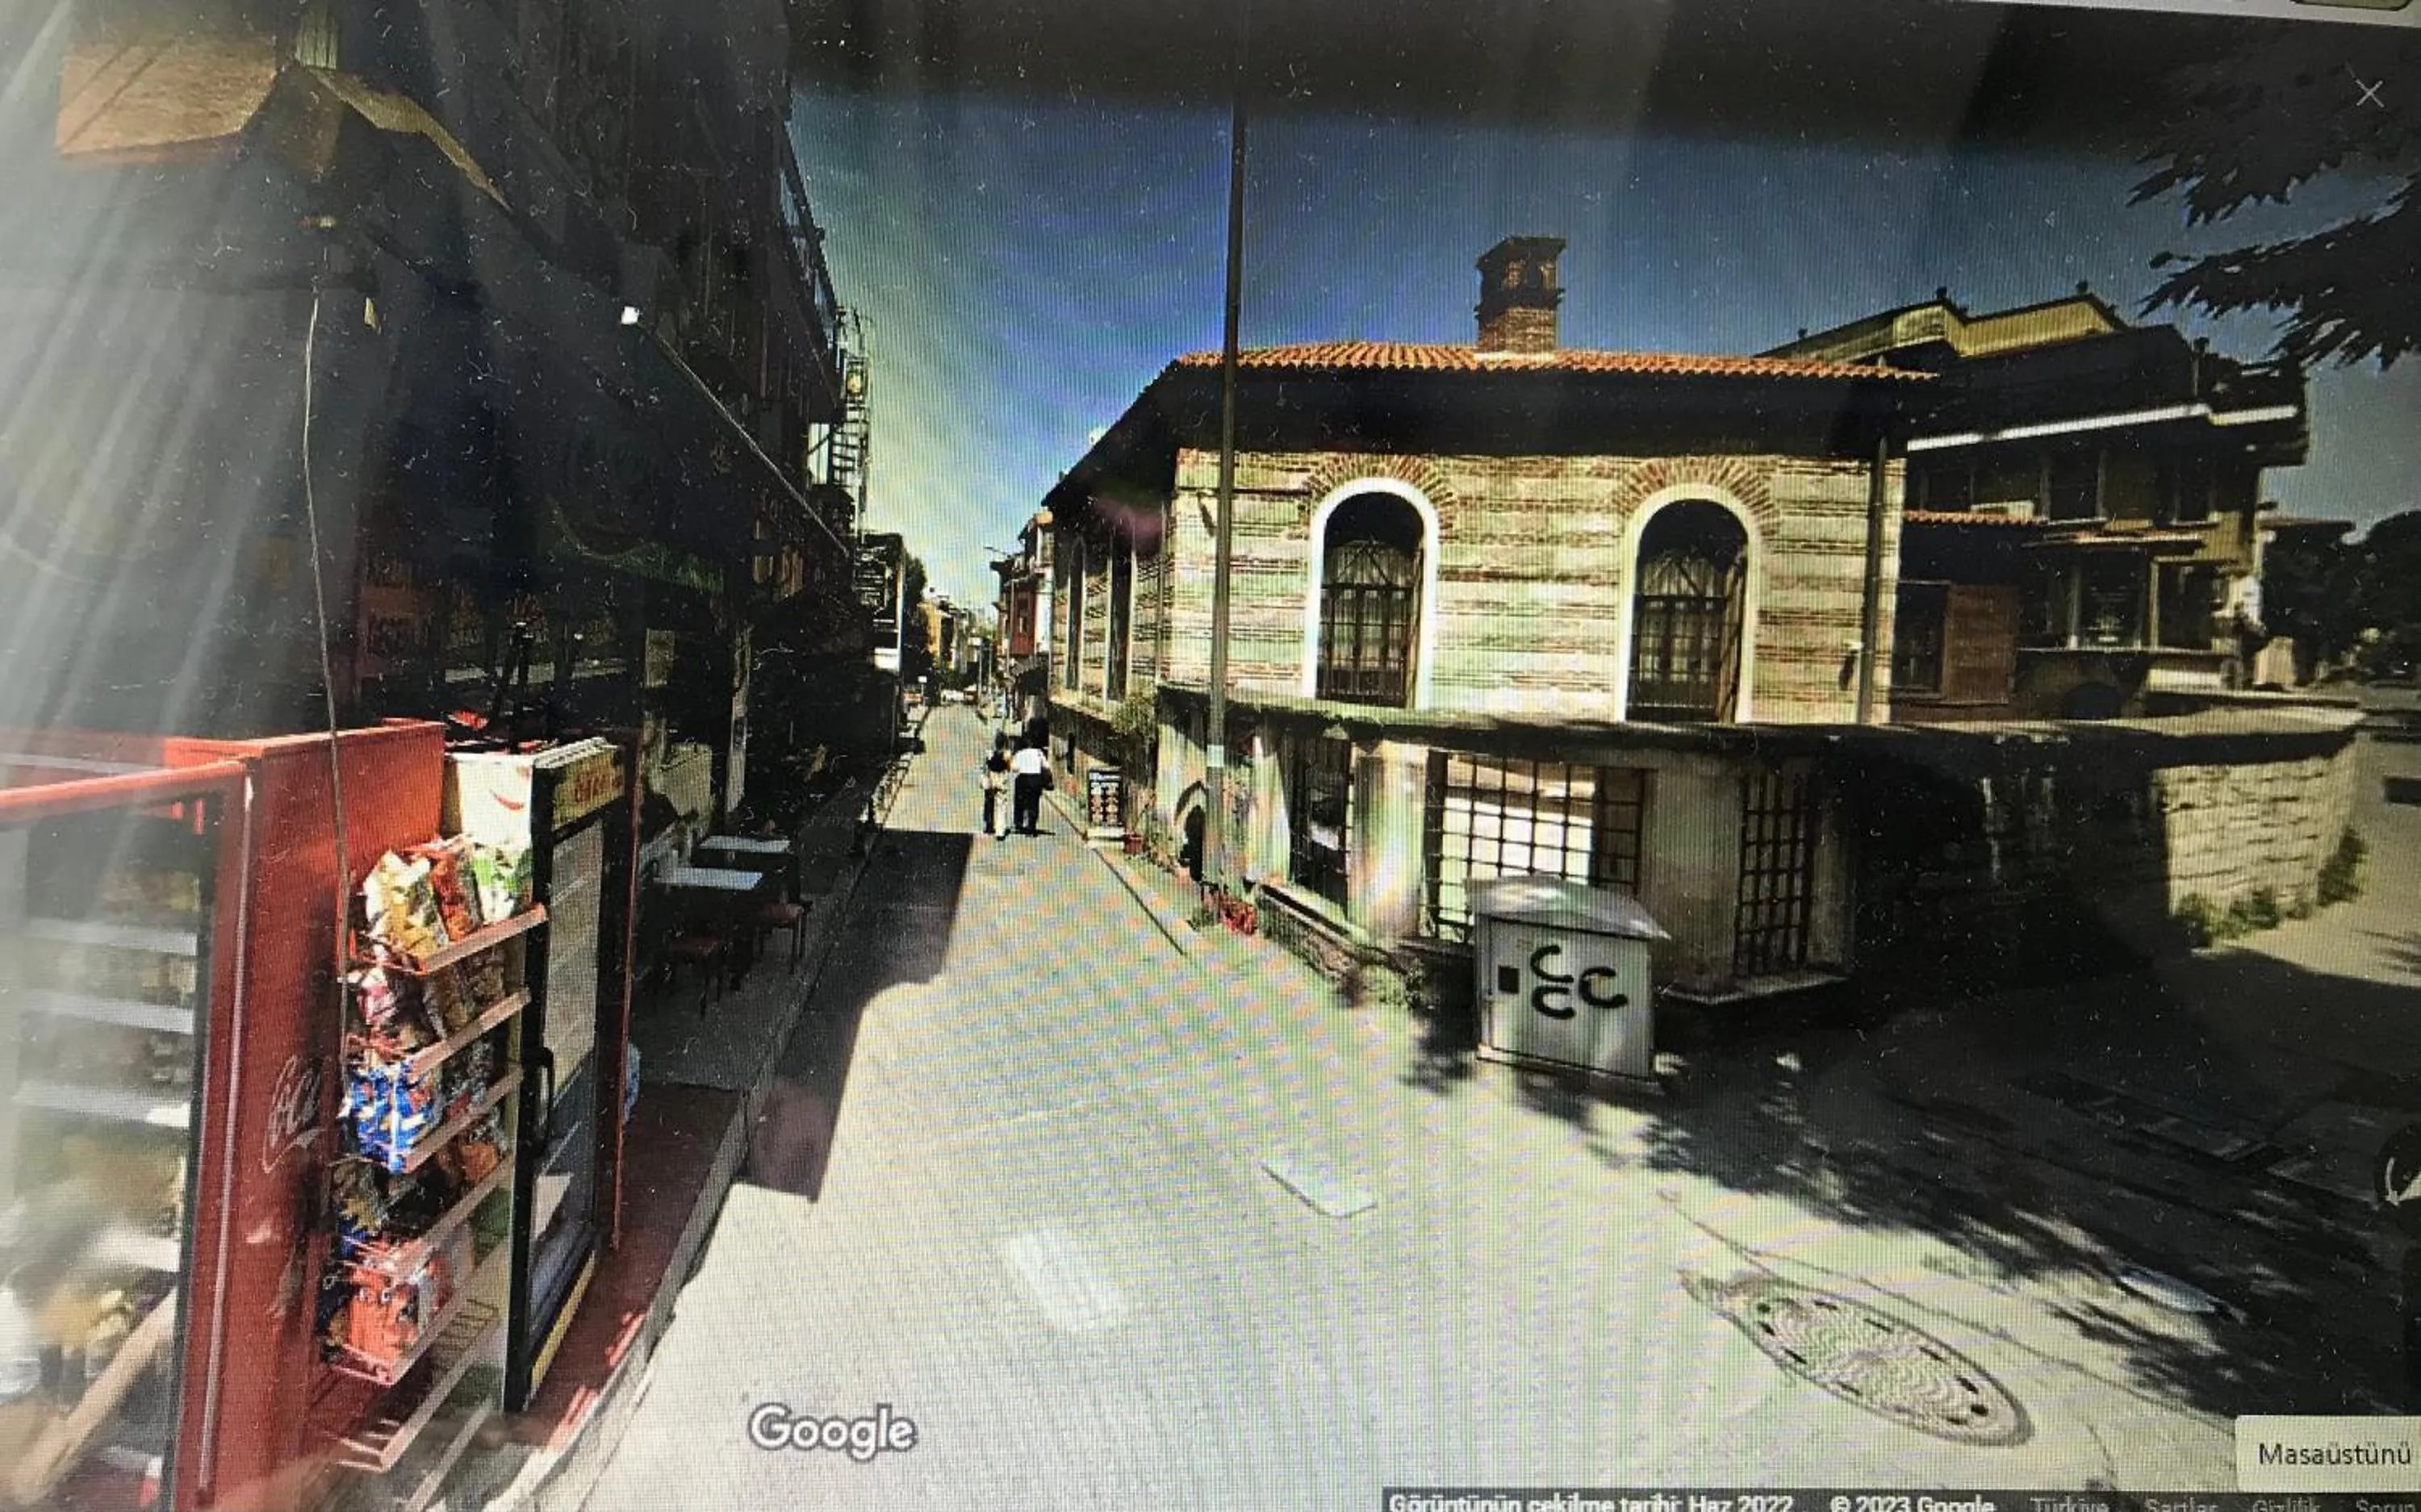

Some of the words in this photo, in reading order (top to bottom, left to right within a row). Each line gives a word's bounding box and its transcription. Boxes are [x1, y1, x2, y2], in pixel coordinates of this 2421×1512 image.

[748, 1401, 918, 1462] Google
[2259, 1440, 2412, 1466] Masaüstünü
[1690, 1495, 1733, 1512] Haz
[1737, 1495, 1794, 1512] 2022
[1855, 1496, 1912, 1512] 2023
